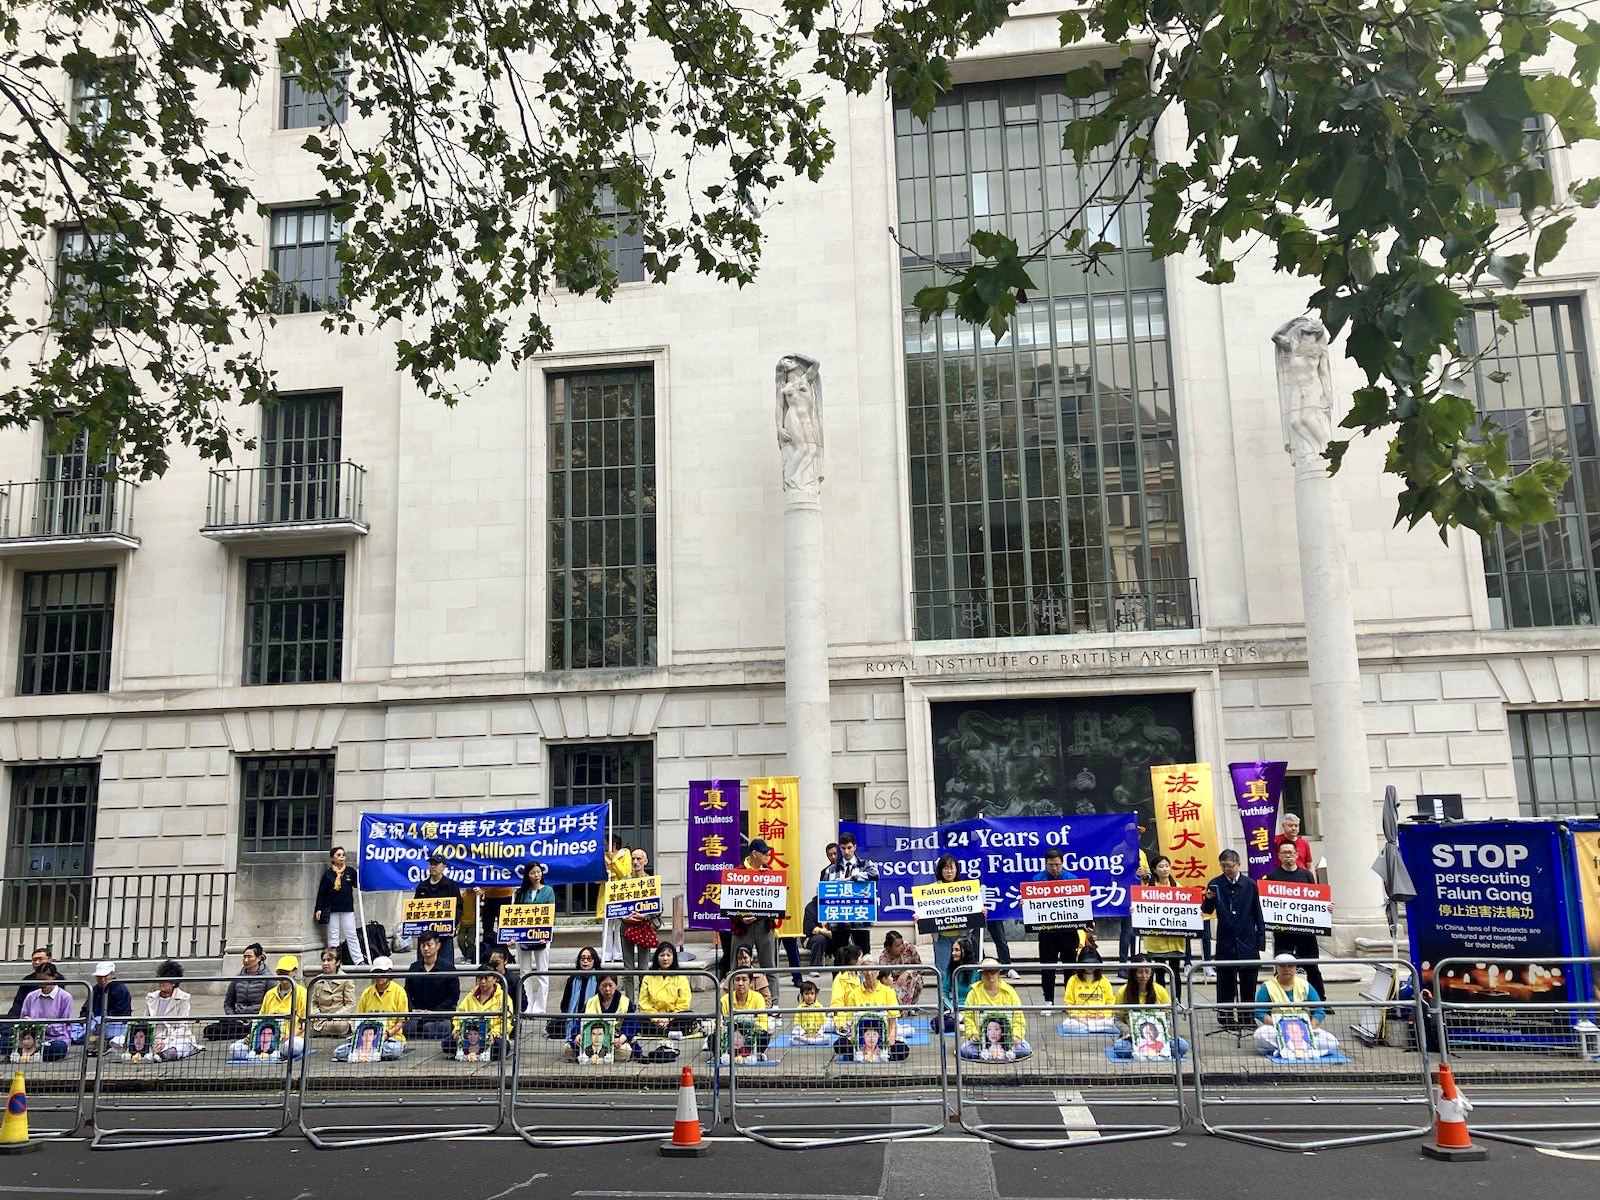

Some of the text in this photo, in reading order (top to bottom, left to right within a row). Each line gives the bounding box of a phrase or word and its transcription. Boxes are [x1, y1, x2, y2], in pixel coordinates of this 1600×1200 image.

[866, 646, 1257, 673] ROYAL INSTITUTE OF BRITISH ARCHITECTS
[700, 788, 728, 810] 真
[875, 790, 902, 809] 66
[895, 825, 1072, 852] End 24 Years of
[365, 843, 430, 863] Support
[471, 841, 525, 860] Million
[530, 838, 597, 857] Chinese
[698, 834, 728, 858] 善
[1062, 852, 1125, 875] Gong
[1432, 844, 1529, 869] STOP
[479, 864, 511, 881] The
[726, 872, 783, 885] Stop organ
[1435, 872, 1531, 887] persecuting
[728, 886, 780, 898] harvesting
[825, 883, 853, 897] 三退
[921, 885, 972, 896] Falun Gong
[1025, 883, 1085, 897] Stop organ
[1141, 890, 1192, 901] Killed for
[1267, 884, 1320, 898] Killed for
[1437, 887, 1532, 904] Falun Gong
[635, 900, 659, 912] China
[734, 899, 773, 909] in China
[917, 895, 965, 908] persecuted
[966, 894, 979, 902] for
[1029, 897, 1085, 909] harvesting
[1262, 899, 1327, 912] their organs
[824, 905, 869, 920] 保平安
[926, 905, 973, 916] meditating
[1037, 911, 1079, 922] in China
[1136, 903, 1198, 917] their organs
[1438, 904, 1534, 919] 停止迫害法輪功
[944, 916, 968, 924] China
[1148, 917, 1187, 927] in China
[1273, 912, 1315, 924] in China
[429, 922, 452, 932] China
[527, 929, 550, 939] China
